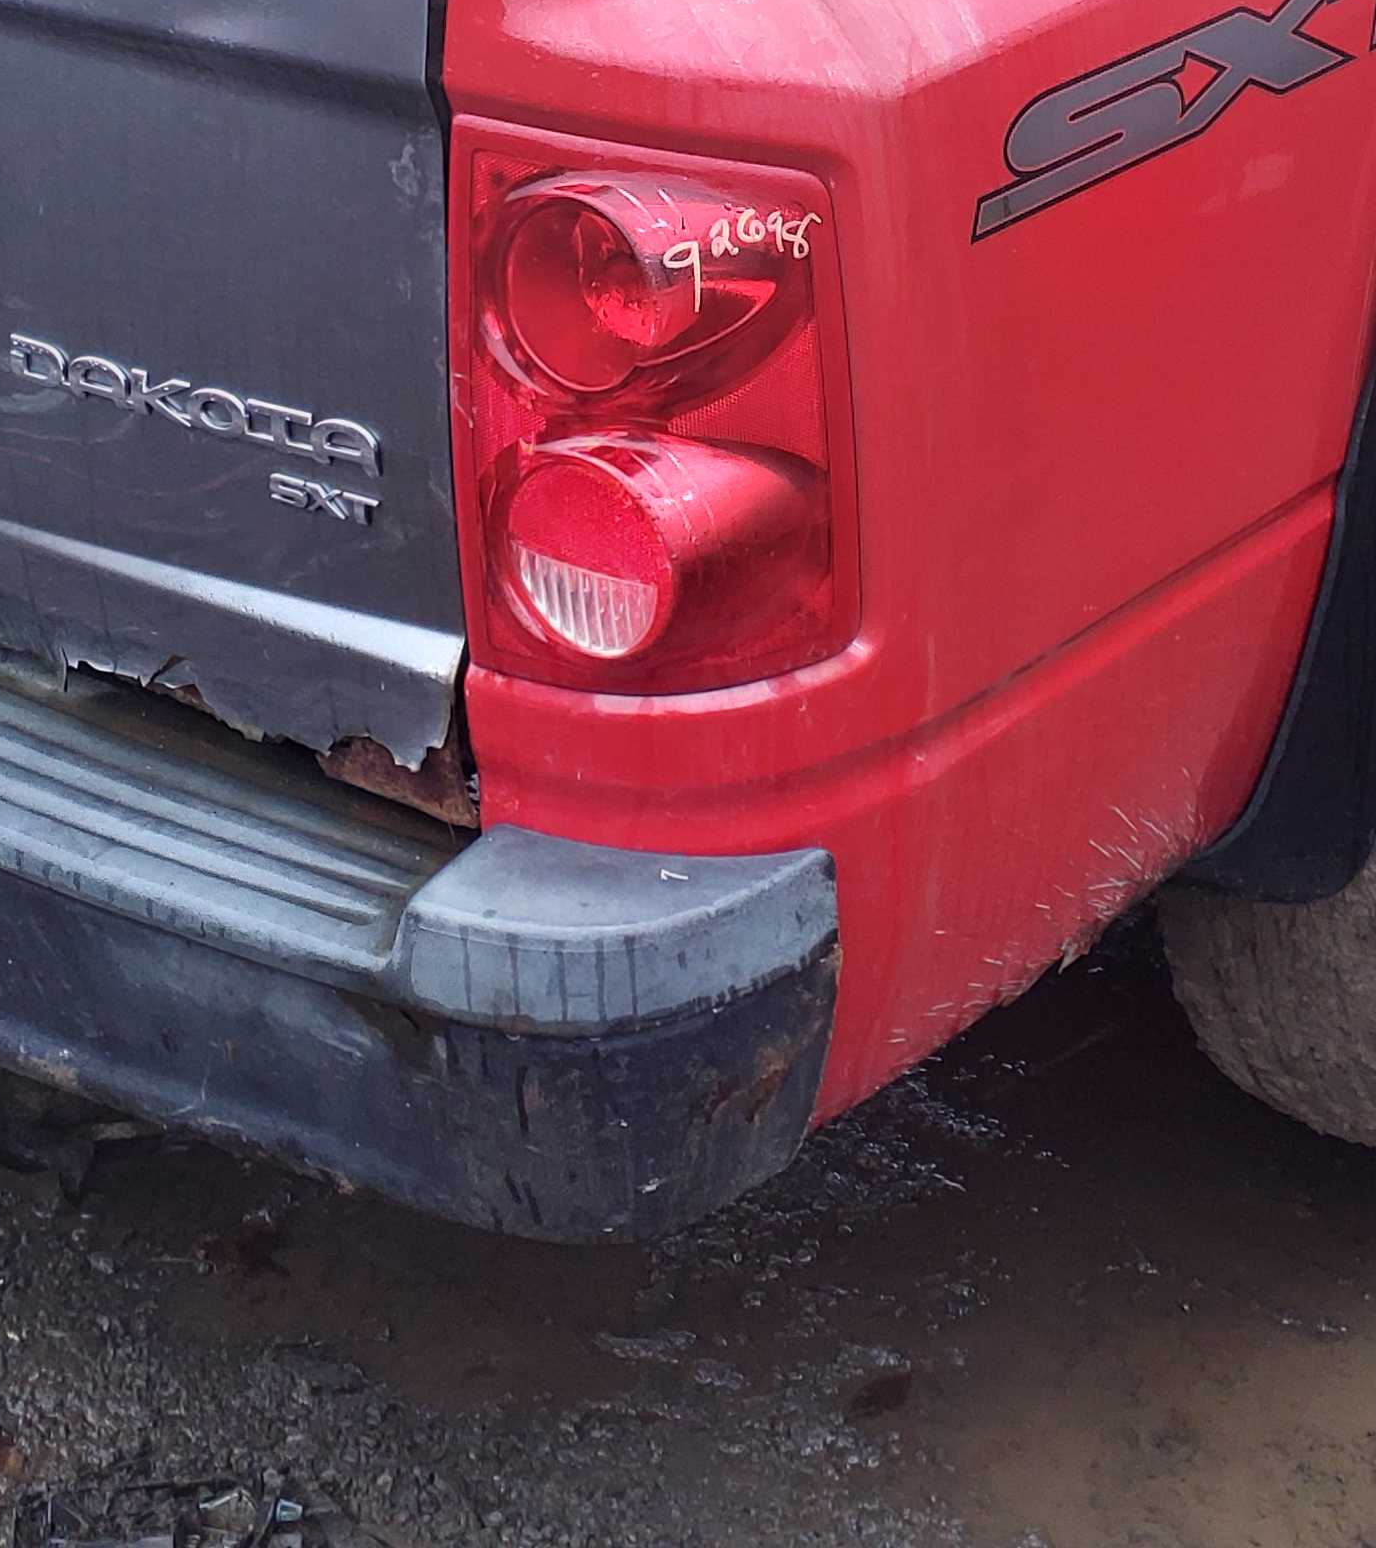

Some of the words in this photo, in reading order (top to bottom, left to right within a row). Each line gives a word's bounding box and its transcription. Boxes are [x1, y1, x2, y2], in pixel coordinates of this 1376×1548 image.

[662, 208, 823, 314] 92698
[9, 332, 385, 479] DAKOTA
[267, 471, 382, 527] SXT
